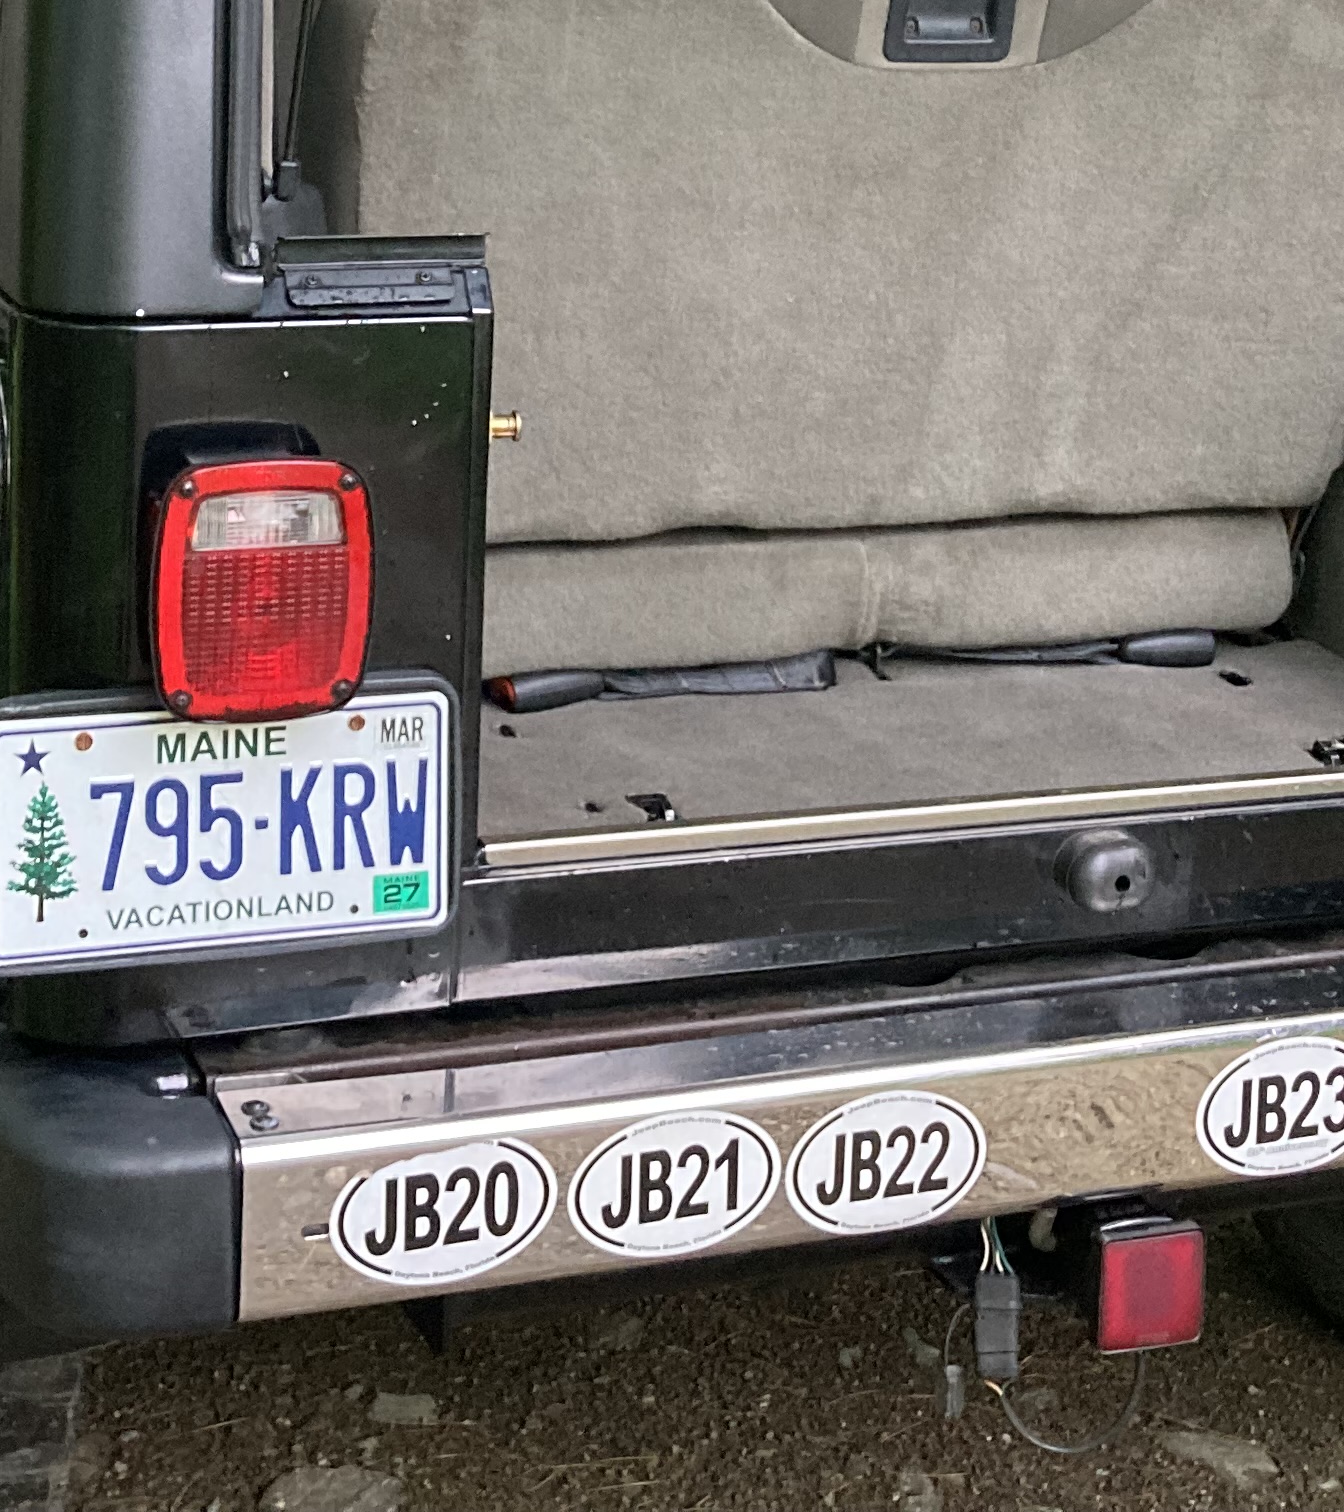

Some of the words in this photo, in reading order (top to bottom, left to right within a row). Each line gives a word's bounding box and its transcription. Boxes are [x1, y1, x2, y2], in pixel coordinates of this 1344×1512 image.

[157, 725, 287, 764] MAINE
[381, 716, 424, 743] MAR
[89, 754, 429, 891] 795-KRW
[106, 890, 335, 931] VACATIONLAND
[383, 883, 421, 904] 27
[601, 1137, 740, 1229] JB21
[816, 1121, 951, 1206] JB22
[364, 1160, 520, 1256] JB20
